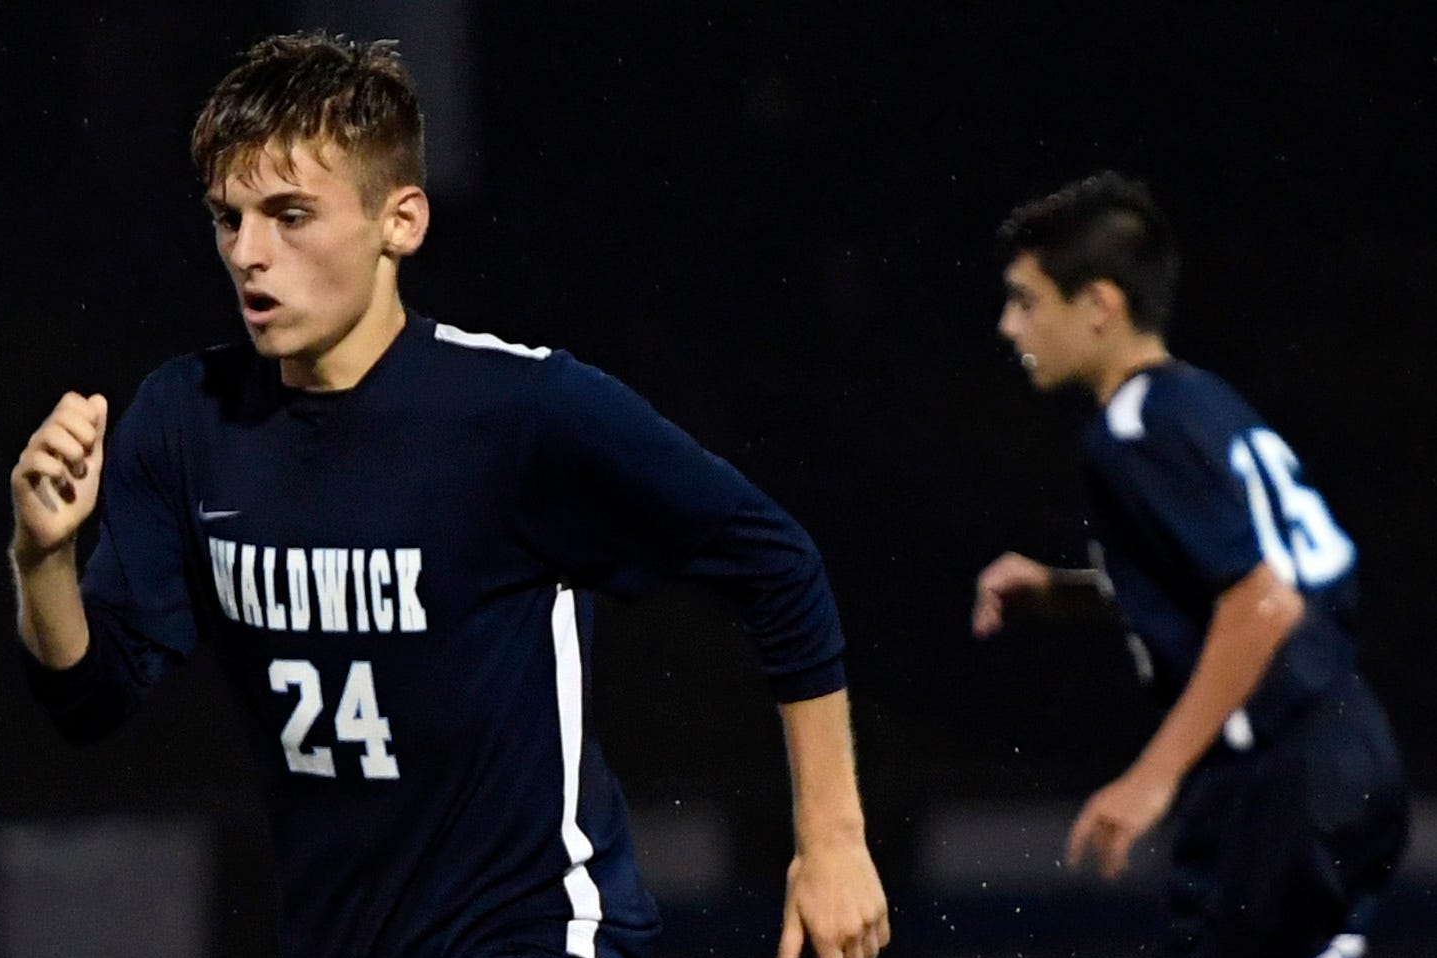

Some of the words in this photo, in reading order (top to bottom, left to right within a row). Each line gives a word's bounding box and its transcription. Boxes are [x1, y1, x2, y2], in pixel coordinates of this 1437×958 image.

[1228, 427, 1357, 589] 15
[209, 535, 428, 633] WALDWICK
[268, 658, 401, 780] 24
